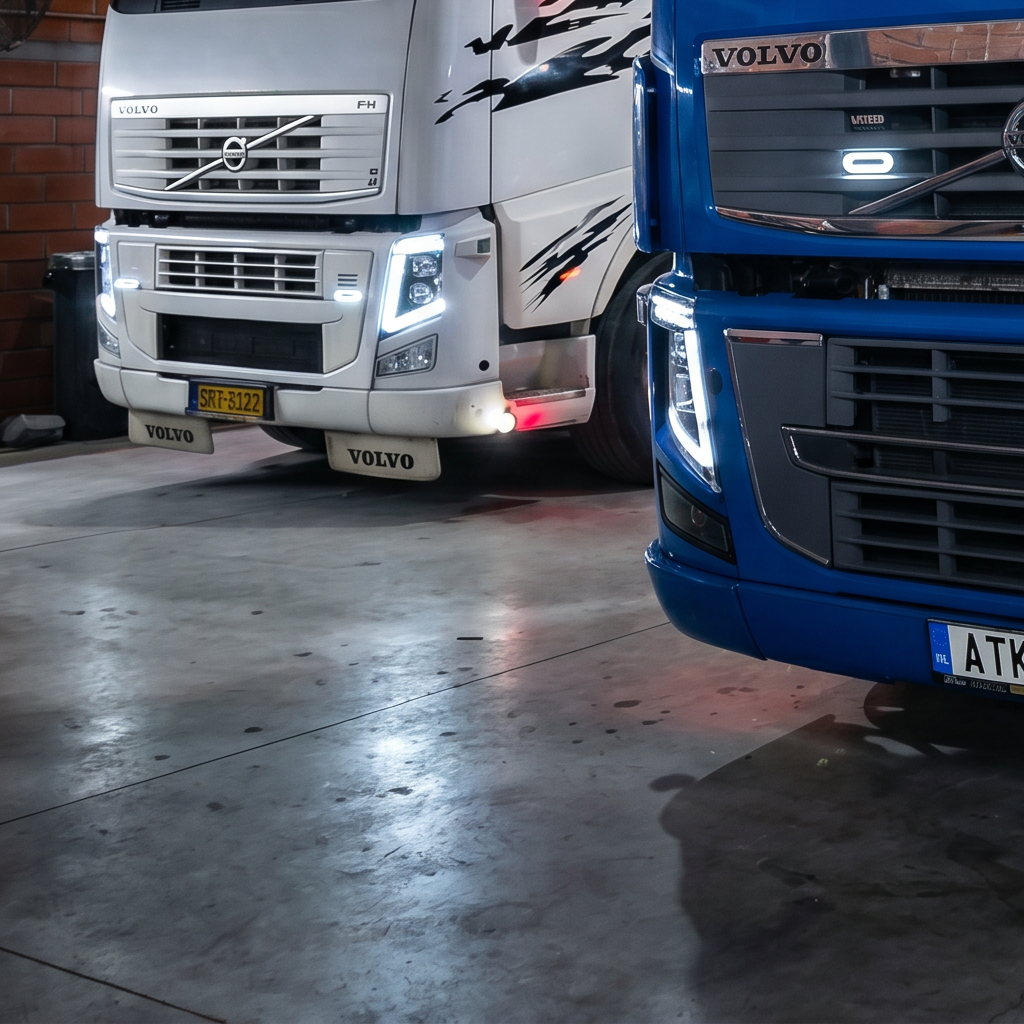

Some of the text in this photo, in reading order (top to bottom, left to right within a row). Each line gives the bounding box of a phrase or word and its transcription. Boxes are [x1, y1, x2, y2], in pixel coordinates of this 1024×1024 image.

[711, 41, 823, 68] VOLVO
[118, 105, 159, 115] VOLVO
[357, 100, 377, 110] FH
[144, 424, 194, 444] VOLVO
[347, 448, 415, 470] VOLVO
